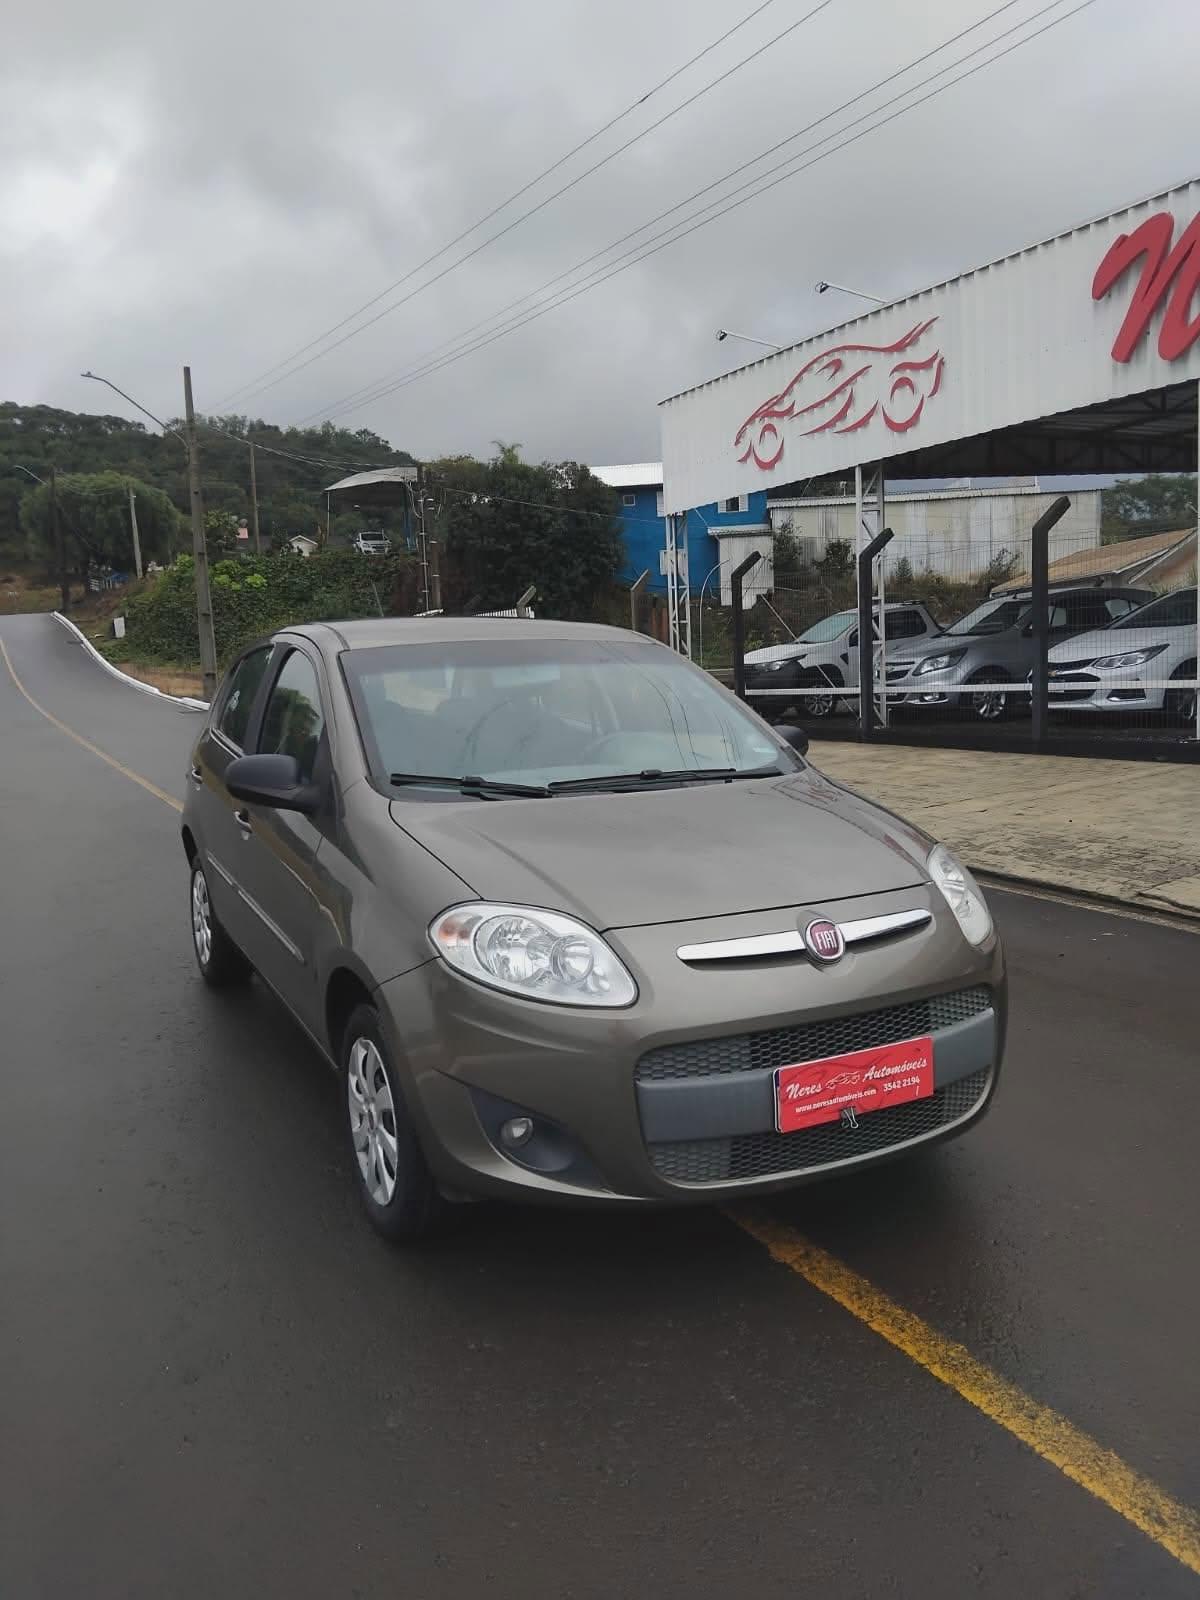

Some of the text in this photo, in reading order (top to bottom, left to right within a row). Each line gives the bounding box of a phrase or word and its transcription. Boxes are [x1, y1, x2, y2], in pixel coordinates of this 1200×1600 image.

[815, 930, 837, 950] FIAT
[786, 1057, 928, 1099] Neres Automóveis
[883, 1080, 901, 1092] 3542
[902, 1075, 920, 1087] 2194
